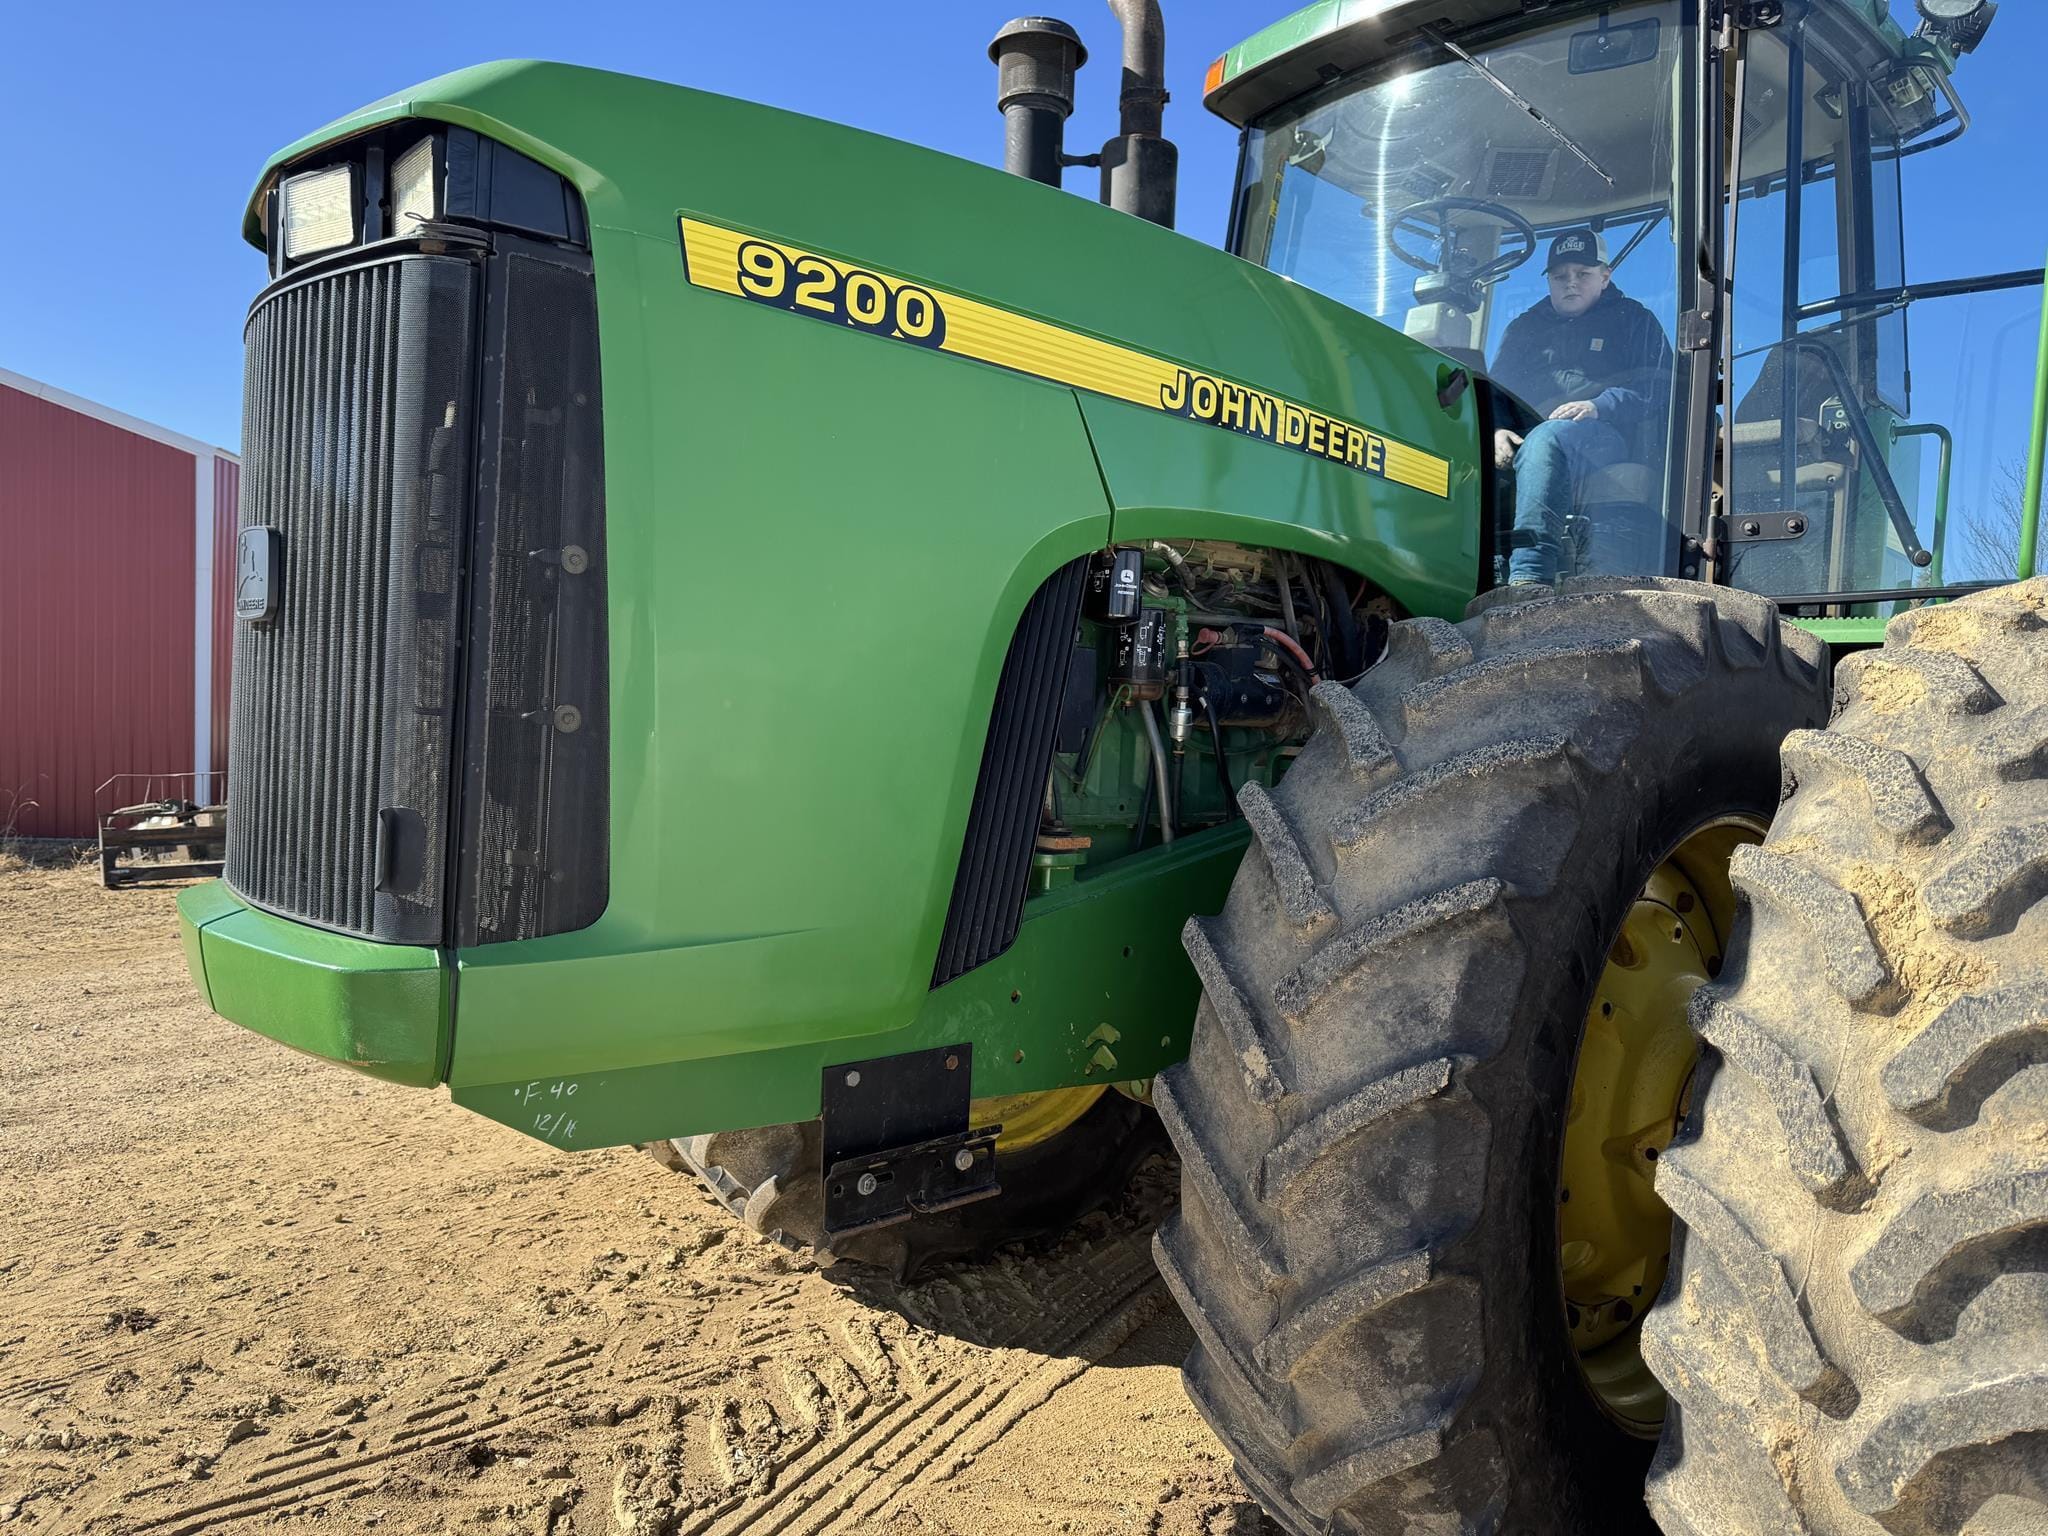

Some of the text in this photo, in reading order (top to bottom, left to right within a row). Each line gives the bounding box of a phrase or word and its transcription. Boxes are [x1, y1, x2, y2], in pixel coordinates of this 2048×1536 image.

[738, 242, 937, 339] 9200
[1161, 371, 1383, 473] JOHN DEERE
